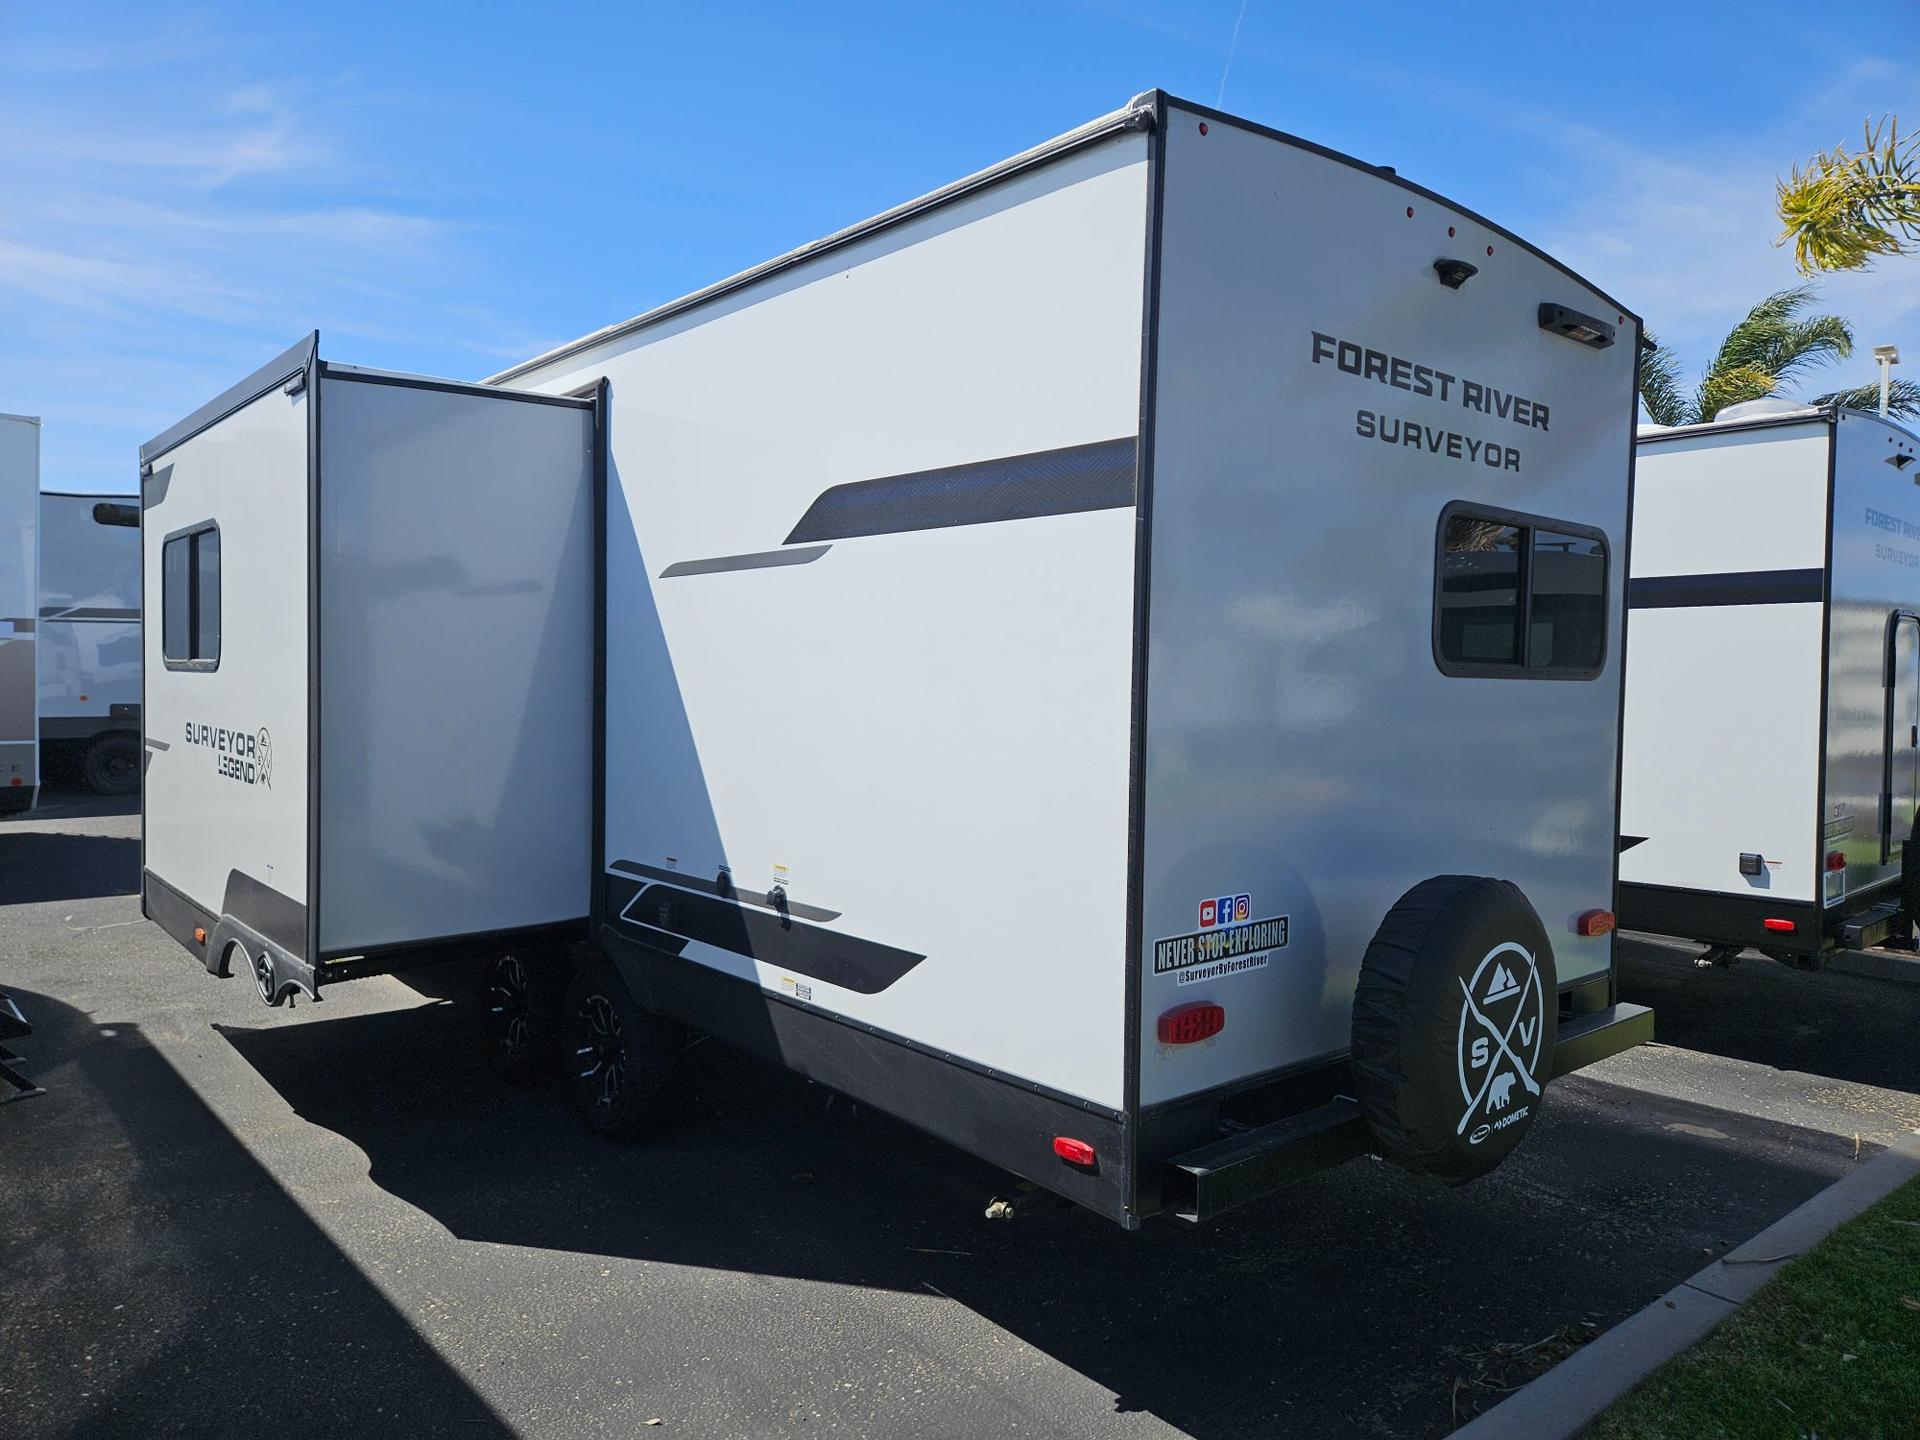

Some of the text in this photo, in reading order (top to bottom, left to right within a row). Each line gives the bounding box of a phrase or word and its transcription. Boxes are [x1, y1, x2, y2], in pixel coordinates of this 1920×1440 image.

[1311, 330, 1550, 432] FOREST RIVER
[1356, 409, 1521, 473] SURVEYOR
[1865, 506, 1901, 536] FOREST
[185, 721, 256, 759] SURVEYOR
[218, 753, 255, 785] LEGEND
[1158, 919, 1286, 970] NEVER STOP EXPLORING
[1178, 955, 1268, 983] @SurveyorByForestRiver
[1518, 1016, 1537, 1047] V
[1471, 1036, 1489, 1069] S
[1502, 1105, 1529, 1128] DOMETIC
